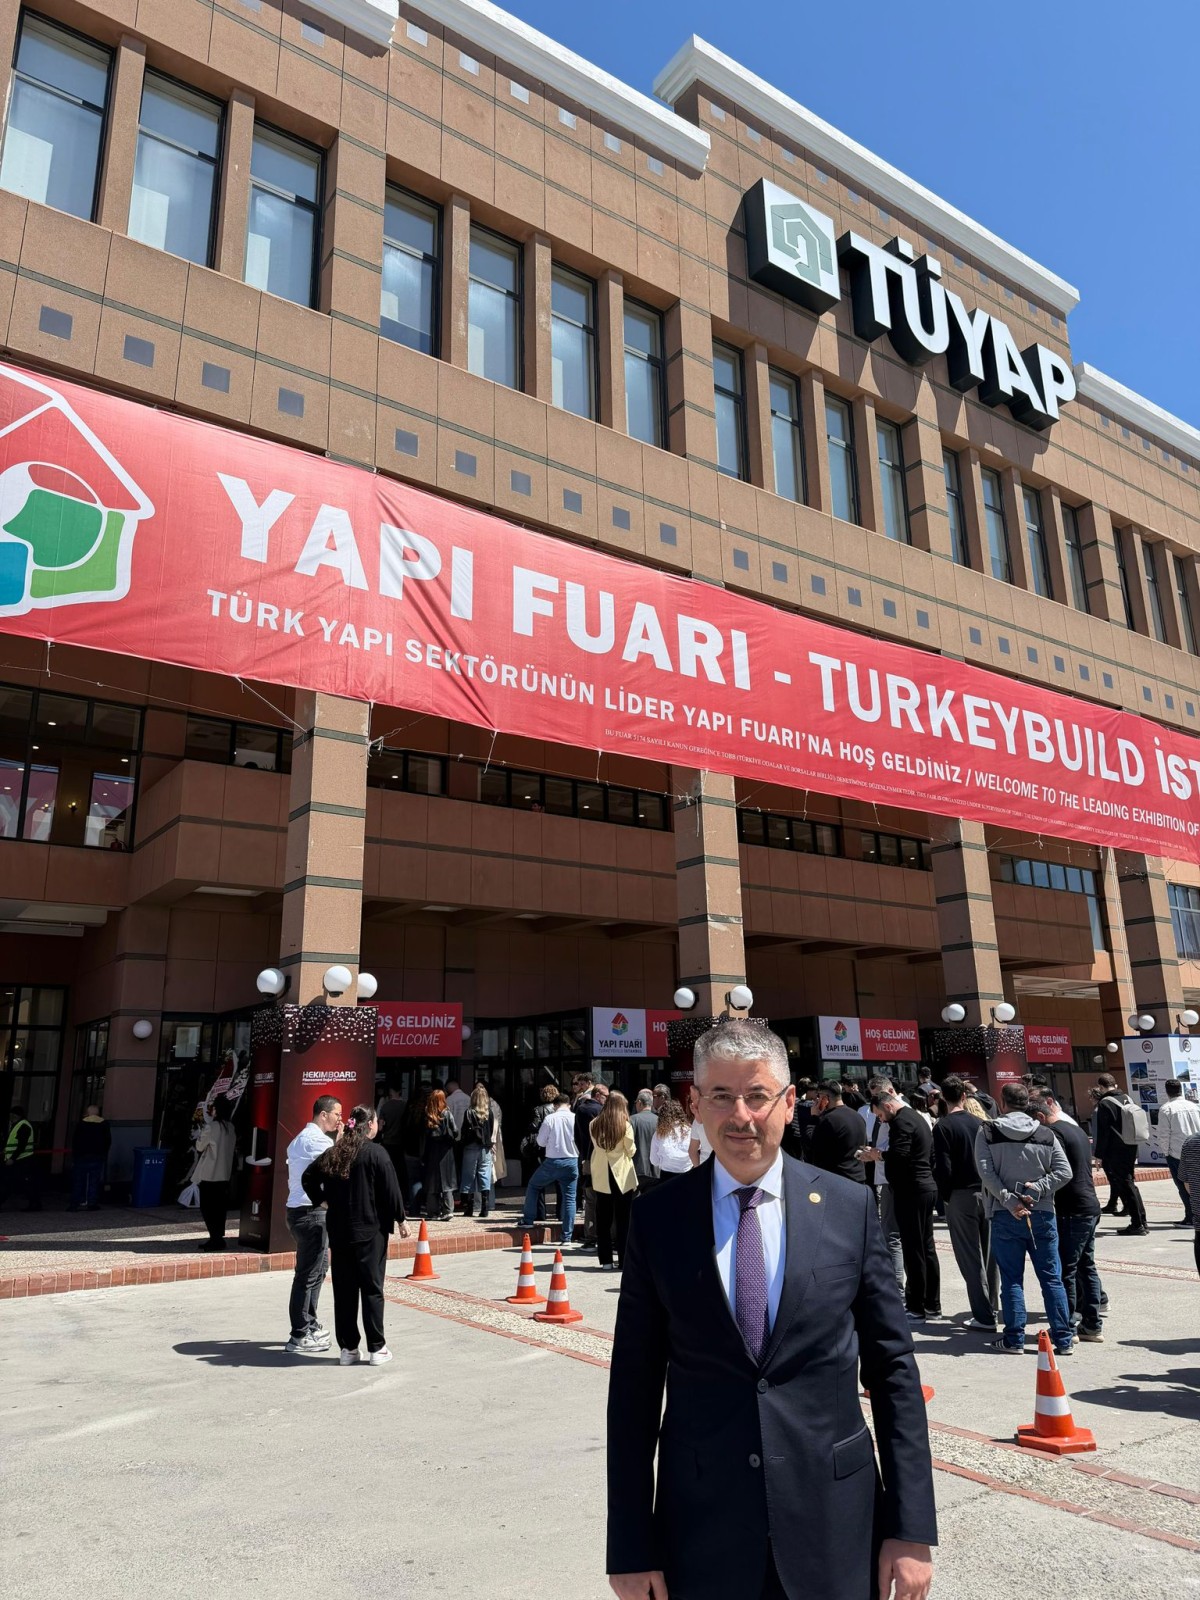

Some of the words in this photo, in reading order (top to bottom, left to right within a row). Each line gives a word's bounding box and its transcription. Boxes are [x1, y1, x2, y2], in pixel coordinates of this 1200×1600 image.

[849, 230, 1076, 420] TÜYAP
[216, 471, 475, 621] YAPI
[511, 564, 751, 691] FUARI
[773, 670, 792, 685] -
[808, 651, 1145, 787] TURKEYBUILD
[206, 588, 305, 638] TÜRK
[317, 615, 394, 658] YAPI
[404, 638, 595, 705] SEKTÖRÜNÜN
[604, 684, 675, 722] LİDER
[682, 704, 733, 734] YAPI
[839, 741, 876, 771] HOŞ
[881, 751, 962, 783] GELDİNİZ
[974, 770, 1039, 800] WELCOME
[1041, 786, 1056, 804] TO
[1059, 790, 1080, 809] THE
[1082, 796, 1130, 820] LEADING
[1132, 807, 1186, 833] EXHIBITION
[1187, 821, 1199, 836] OF
[377, 1015, 393, 1031] OŞ
[396, 1013, 456, 1029] GELDİNİZ
[652, 1021, 669, 1032] HO
[382, 1033, 440, 1045] WELCOME
[865, 1029, 881, 1041] HOŞ
[882, 1028, 916, 1040] GELDİNİZ
[1028, 1035, 1041, 1045] HOŞ
[1042, 1034, 1069, 1044] GELDİNİZ
[599, 1039, 617, 1048] YAPI
[619, 1040, 643, 1048] FUARI
[825, 1044, 840, 1052] YAPI
[875, 1042, 908, 1053] WELCOME
